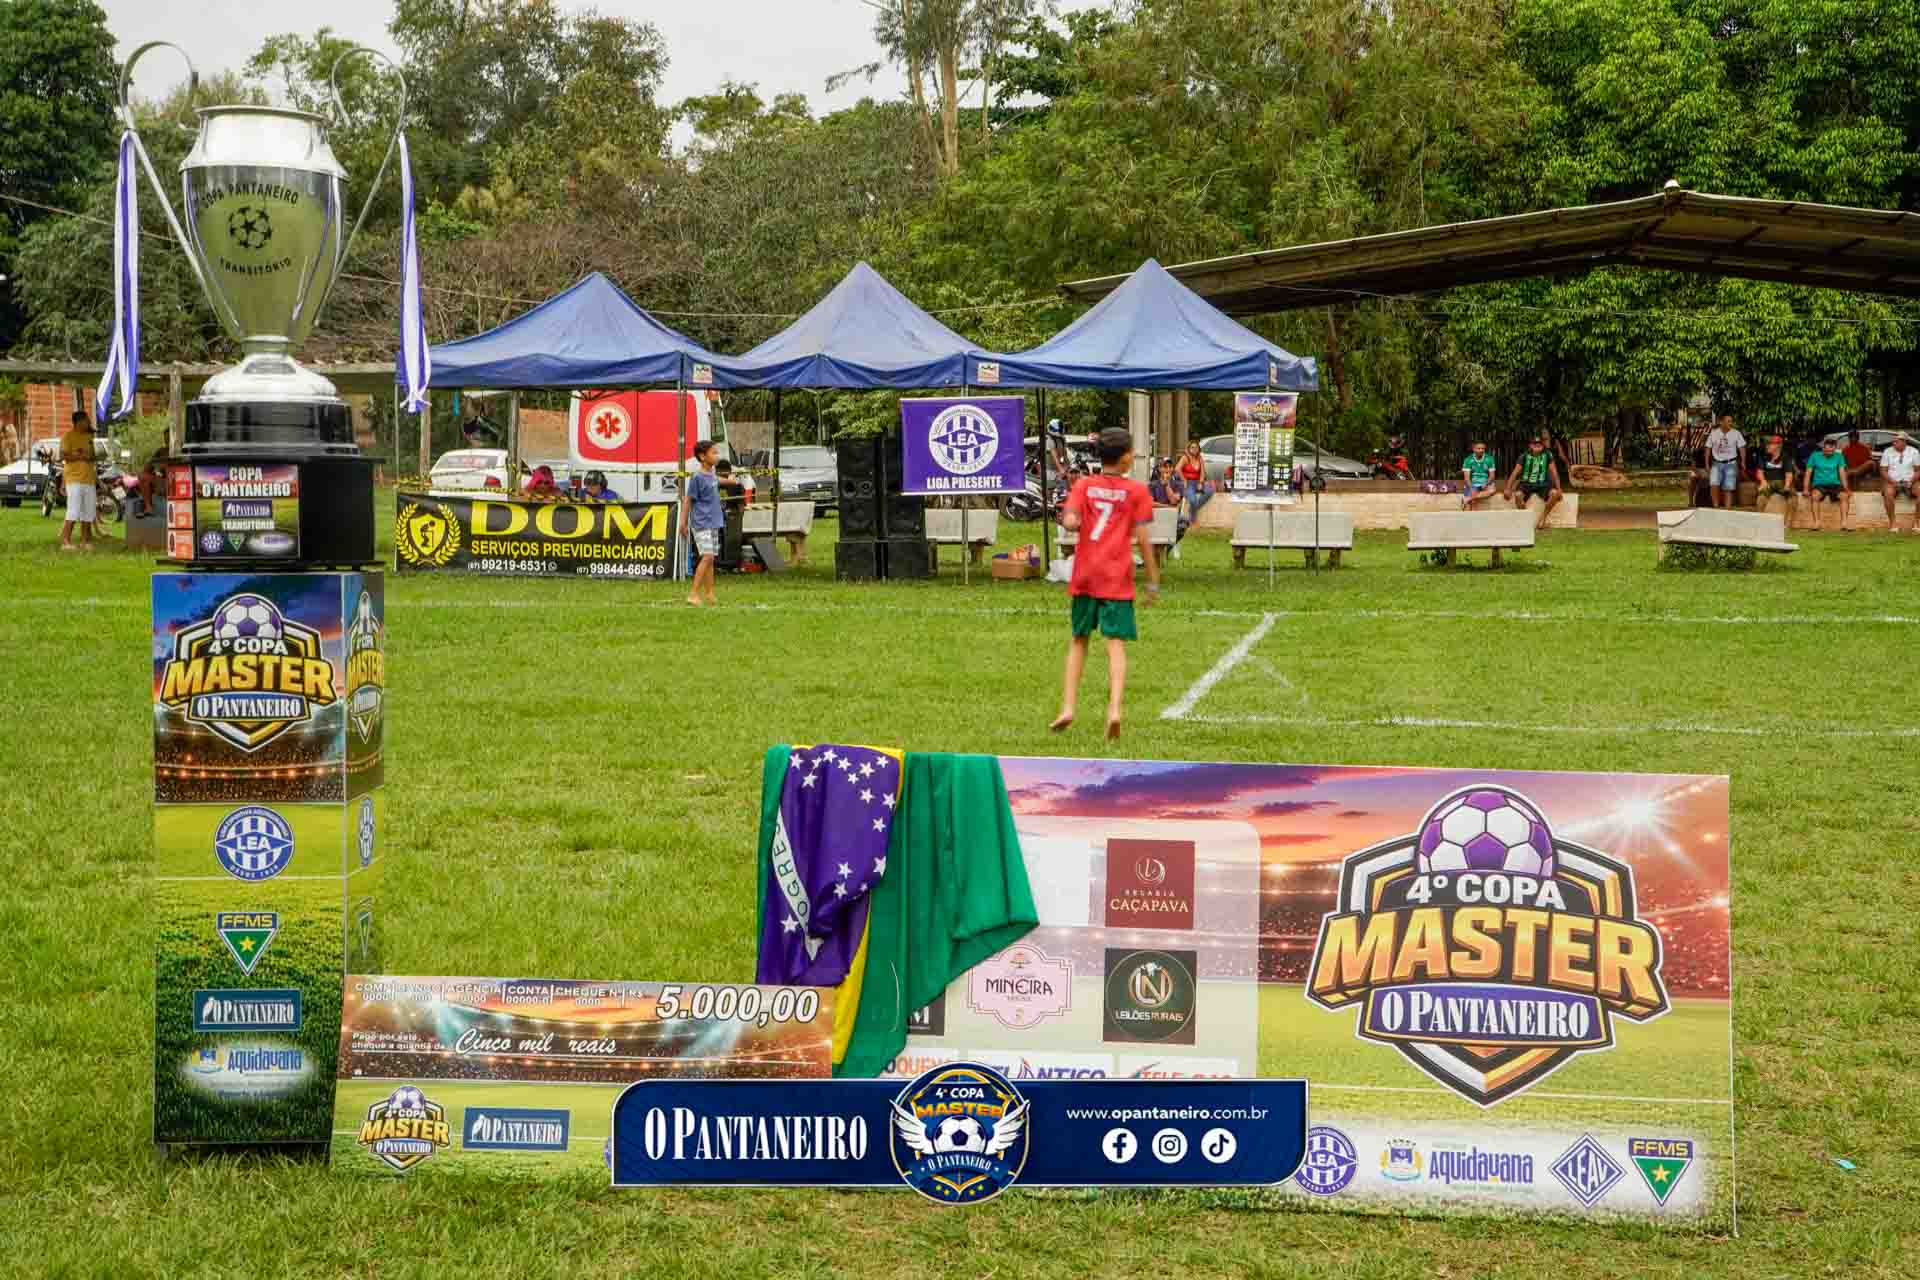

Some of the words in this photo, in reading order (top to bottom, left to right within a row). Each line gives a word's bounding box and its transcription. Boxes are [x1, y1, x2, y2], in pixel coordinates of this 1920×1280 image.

[229, 183, 299, 205] PANTANEIRO
[948, 431, 979, 446] LEA
[229, 466, 263, 481] COPA
[926, 476, 951, 490] LIGA
[951, 475, 1003, 489] PRESENTE
[470, 500, 670, 541] DOM
[1090, 501, 1113, 541] 7
[470, 539, 539, 559] SERVIÇOS
[542, 541, 666, 560] PREVIDENCIÁRIOS
[481, 559, 548, 572] 99219-6531
[589, 563, 654, 576] 99844-6694
[233, 638, 289, 656] COPA
[160, 653, 338, 705] MASTER
[196, 696, 210, 718] O
[212, 695, 301, 718] PANTANEIRO
[236, 834, 272, 851] LEA
[1456, 874, 1567, 911] COPA
[1110, 898, 1189, 914] CAÇAPAVA
[221, 914, 273, 928] FFMS
[1312, 906, 1661, 1005] MASTER
[508, 985, 549, 995] CONTA
[556, 986, 606, 998] CHEQUE
[984, 977, 1054, 996] MINEIRA
[655, 984, 820, 1029] 5.000,00
[1381, 991, 1404, 1032] O
[1408, 990, 1590, 1039] PANTANEIRO
[455, 1028, 512, 1054] Cinco
[518, 1031, 553, 1054] mil
[567, 1035, 617, 1053] reais
[399, 1108, 427, 1119] COPA
[358, 1118, 450, 1146] MASTER
[1632, 1140, 1690, 1157] FFMS
[1307, 1152, 1339, 1169] LEA
